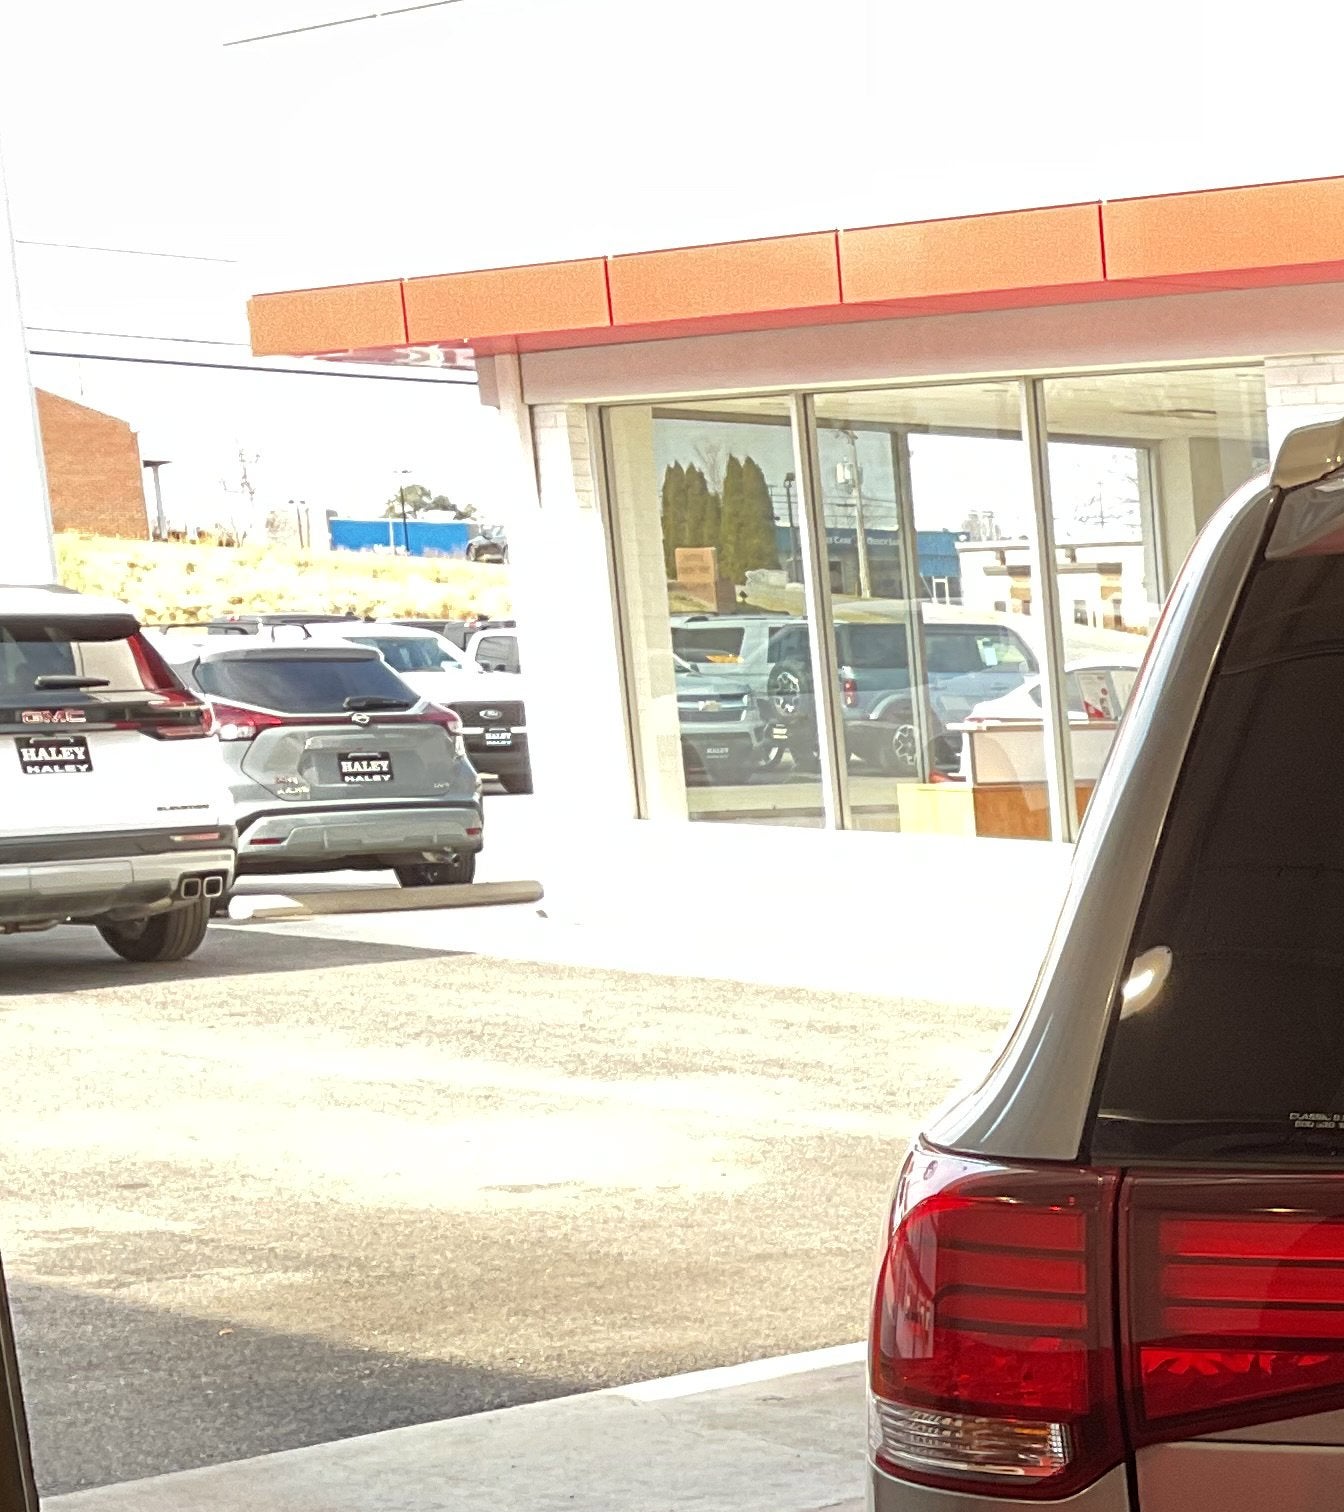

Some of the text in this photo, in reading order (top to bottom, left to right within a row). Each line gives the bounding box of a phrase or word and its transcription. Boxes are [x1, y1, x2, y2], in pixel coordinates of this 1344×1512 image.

[22, 710, 87, 723] GMC
[21, 746, 86, 761] HALEY
[26, 764, 89, 774] HALEY
[340, 760, 390, 773] HALEY
[344, 774, 391, 783] HALEY
